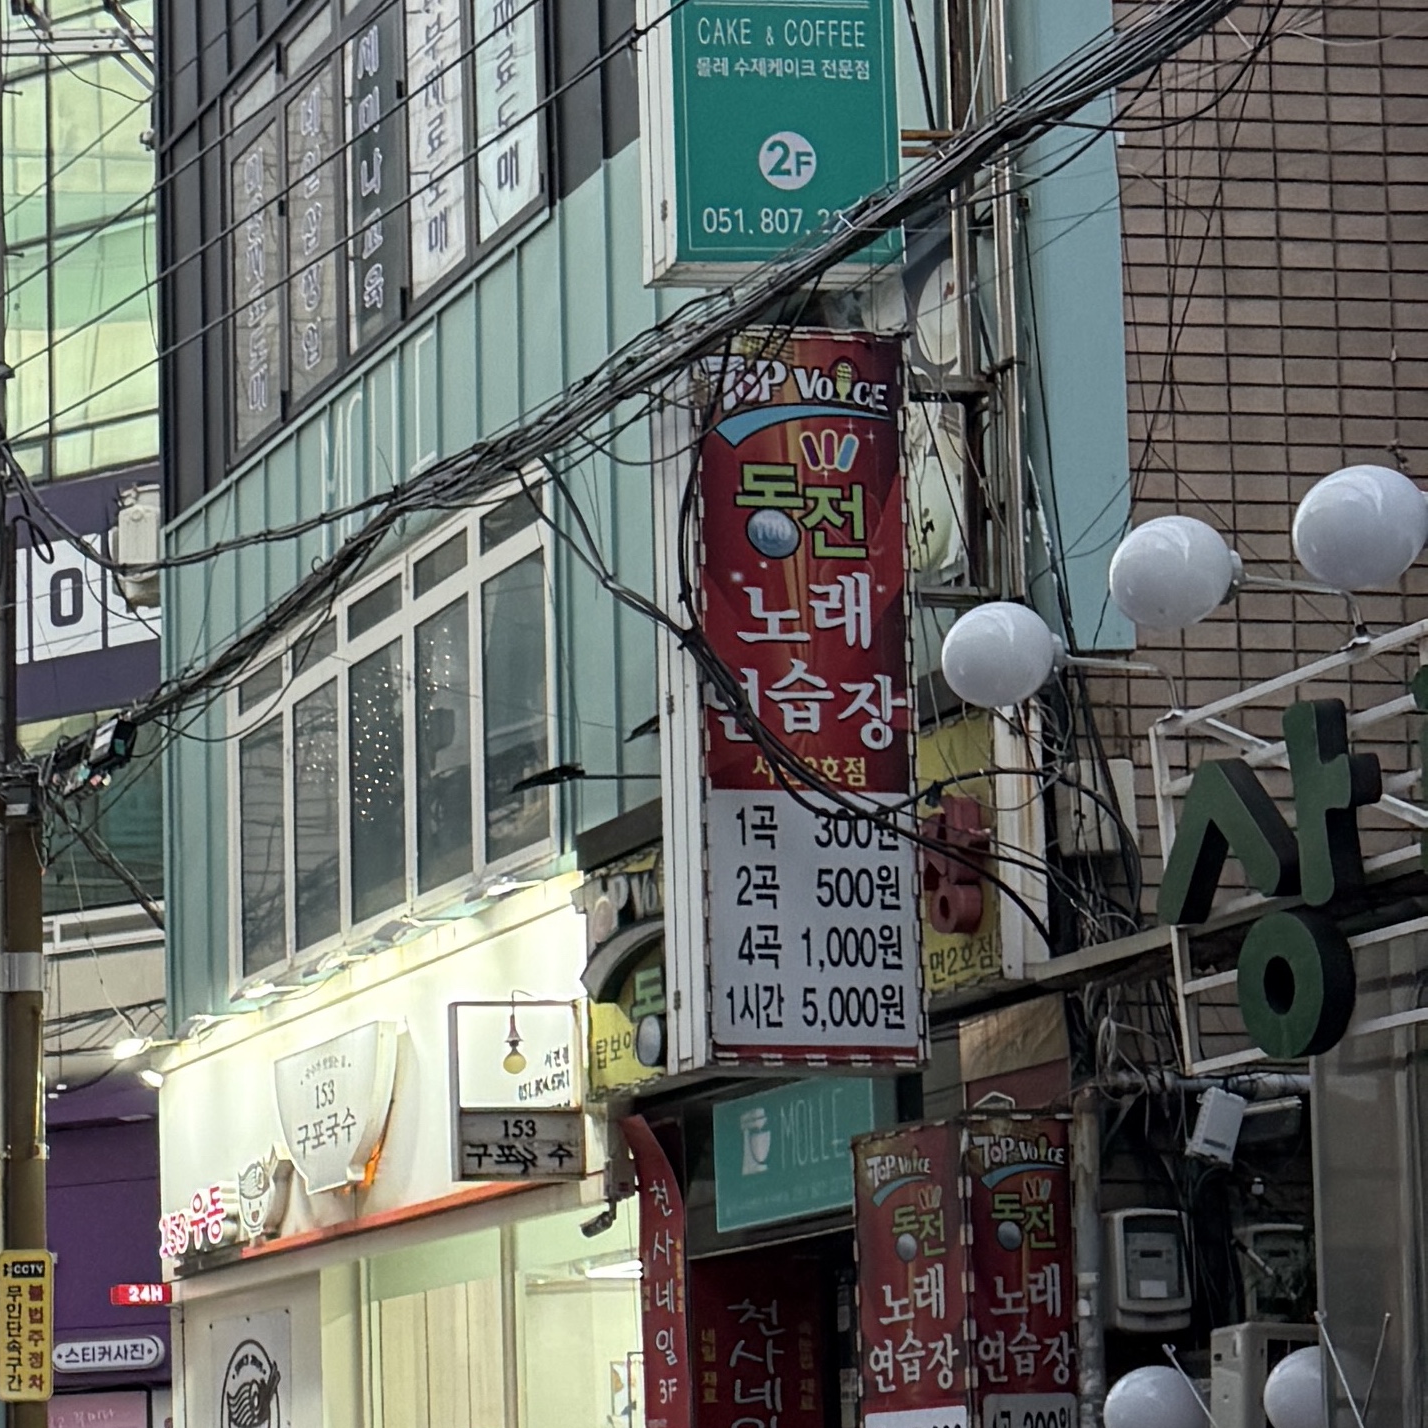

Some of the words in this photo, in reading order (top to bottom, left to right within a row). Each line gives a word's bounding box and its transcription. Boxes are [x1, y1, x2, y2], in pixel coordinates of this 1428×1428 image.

[697, 17, 752, 46] CAKE
[766, 25, 775, 45] &
[784, 20, 866, 48] COFFEE
[734, 57, 817, 79] 수제케이크
[821, 59, 870, 80] 전문점
[766, 140, 814, 177] 2F
[703, 355, 788, 411] TOP
[737, 572, 873, 650] 노래
[735, 804, 779, 851] 1곡
[814, 808, 900, 851] 300원
[735, 864, 781, 910] 2곡
[816, 865, 902, 911] 500원
[1157, 697, 1361, 1060] 상
[738, 924, 783, 970] 4곡
[801, 924, 904, 972] 1,000원
[726, 982, 785, 1029] 1시간
[801, 983, 906, 1032] 5,000원
[315, 1079, 335, 1110] 153
[296, 1106, 357, 1160] 구포국수
[503, 1119, 538, 1139] 153
[780, 1087, 846, 1170] MOLLE
[866, 1154, 895, 1188] TOP
[973, 1136, 1016, 1169] TOP
[13, 1262, 44, 1275] CCTV
[990, 1262, 1062, 1319] 노래
[128, 1284, 164, 1303] 24H
[879, 1262, 946, 1326] 노래
[6, 1285, 23, 1393] 무인단속구간
[28, 1284, 45, 1393] 불법주정차
[64, 1344, 146, 1365] 스티커사진
[869, 1328, 960, 1394] 연습장
[977, 1322, 1077, 1386] 연습장
[659, 1377, 678, 1405] 3F
